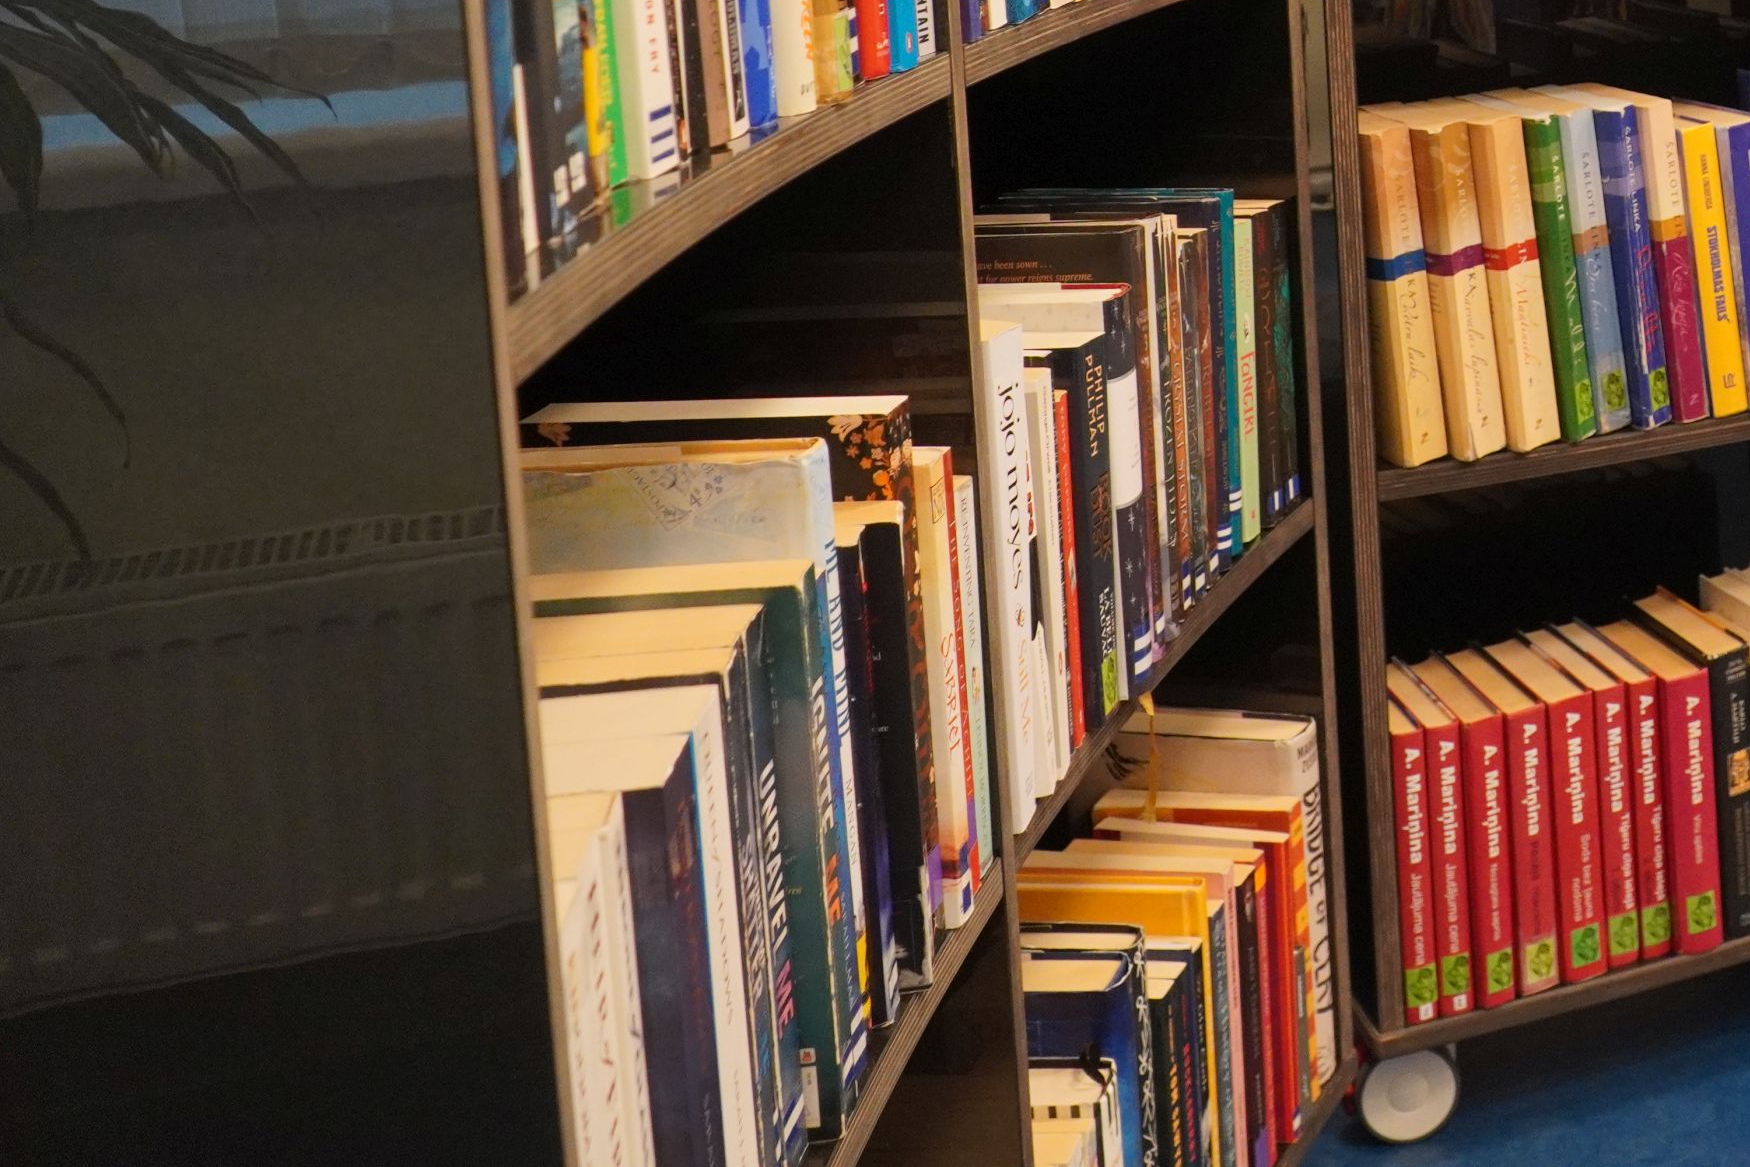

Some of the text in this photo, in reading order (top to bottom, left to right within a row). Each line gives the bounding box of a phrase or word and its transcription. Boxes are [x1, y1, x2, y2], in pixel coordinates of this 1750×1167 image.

[1707, 225, 1725, 293] STOKHOLMAS
[1714, 295, 1729, 322] FAILS
[1084, 355, 1100, 457] PULLMAN
[1092, 365, 1106, 434] PHILIP
[997, 382, 1030, 589] jojo moyes
[1566, 712, 1580, 732] A.
[1605, 702, 1620, 722] A.
[1639, 695, 1654, 715] A.
[1404, 748, 1421, 769] A.
[1439, 741, 1454, 761] A.
[1484, 745, 1498, 765] A.
[1521, 724, 1541, 835] A. Mariņina
[1565, 737, 1585, 824] Mariņina
[1603, 727, 1624, 812] Mariņina
[1636, 720, 1657, 804] Mariņina
[1403, 774, 1423, 864] Mariņina
[1437, 766, 1458, 854] Mariņina
[1481, 770, 1501, 858] Mariņina
